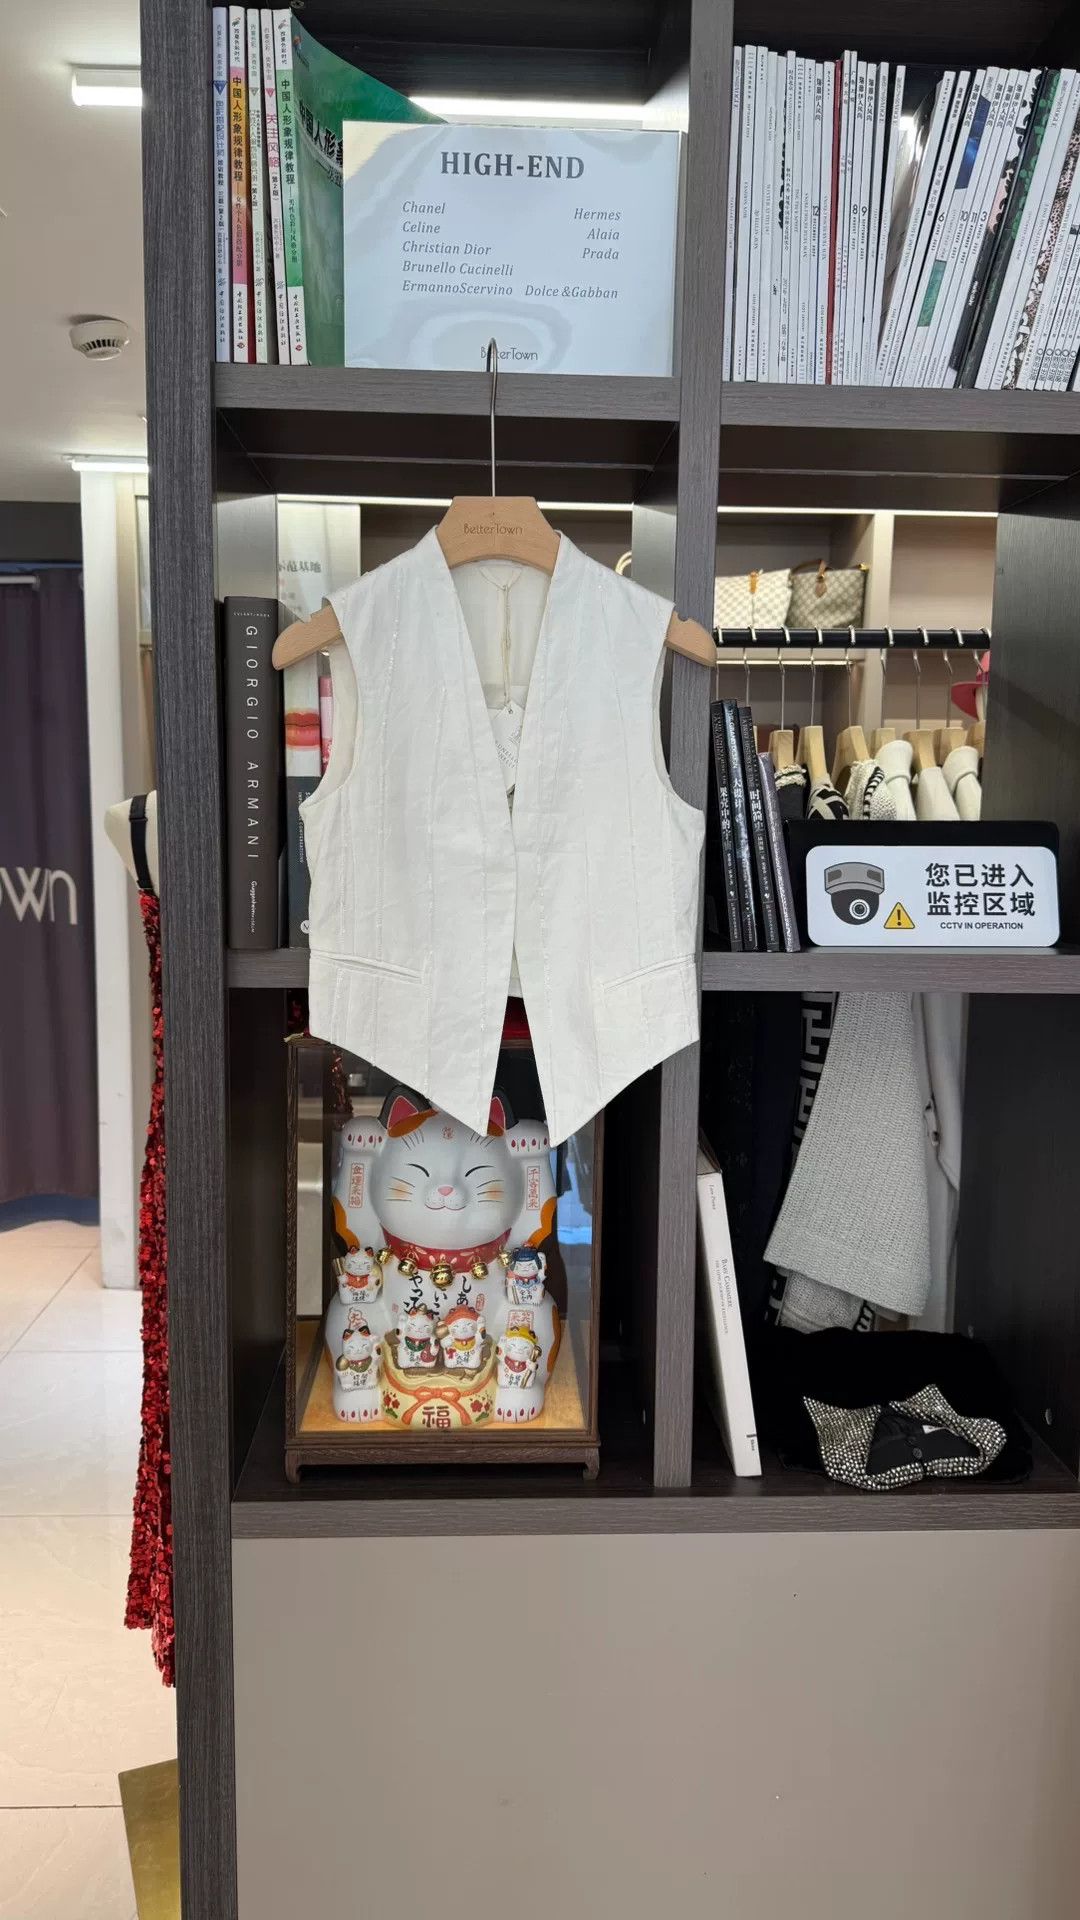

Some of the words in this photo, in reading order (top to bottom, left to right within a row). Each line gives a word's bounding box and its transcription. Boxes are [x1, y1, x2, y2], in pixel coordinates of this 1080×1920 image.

[440, 151, 585, 179] HIGH-END
[402, 201, 446, 215] Chanel
[574, 208, 621, 221] Hermes
[852, 204, 858, 215] 8
[861, 206, 868, 217] 9
[402, 220, 441, 234] Celine
[587, 228, 620, 241] Alaia
[402, 240, 460, 255] Christian
[464, 243, 492, 256] Dior
[582, 247, 619, 260] Prada
[402, 260, 456, 274] Brunello
[459, 262, 514, 277] Cucinelli
[402, 280, 513, 296] ErmannoScervino
[480, 346, 538, 360] BerTown
[463, 523, 523, 535] BetterTown
[245, 625, 259, 739] GIORGIO
[247, 761, 259, 858] ARMANI
[925, 862, 1034, 887] 您已进入
[0, 866, 78, 925] wn
[927, 891, 1036, 917] 监控区域
[975, 922, 1024, 930] OPERATION
[456, 1275, 472, 1305] しあ
[421, 1405, 451, 1429] 福
